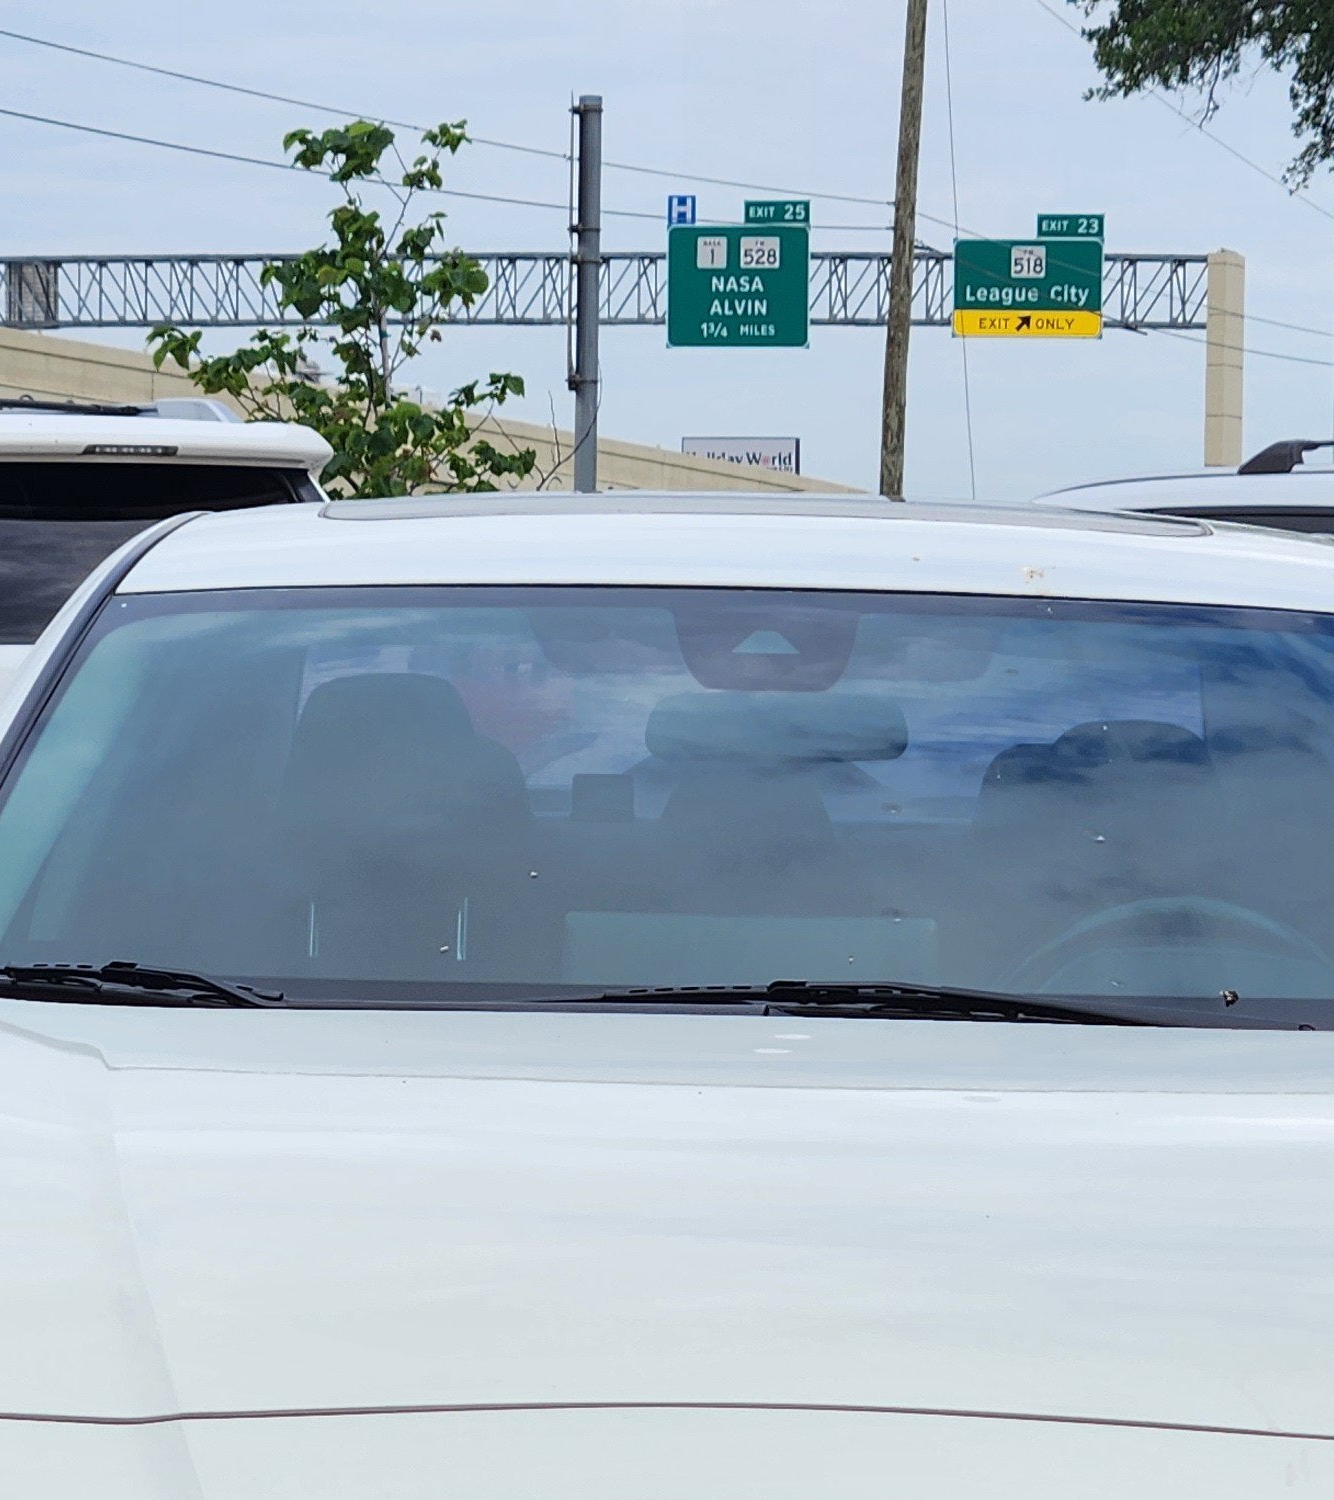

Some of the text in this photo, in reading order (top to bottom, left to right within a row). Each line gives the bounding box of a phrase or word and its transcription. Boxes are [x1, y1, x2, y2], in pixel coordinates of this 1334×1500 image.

[671, 197, 692, 223] H
[749, 204, 806, 220] EXIT 25
[1041, 218, 1099, 233] EXIT 23
[710, 249, 715, 265] 1
[743, 249, 777, 265] 528
[1013, 257, 1043, 275] 518
[711, 276, 764, 292] NASA
[965, 284, 1089, 306] League City
[709, 299, 768, 316] ALVIN
[739, 324, 775, 336] MILES
[979, 317, 1075, 330] EXIT ONLY
[746, 452, 792, 466] World
